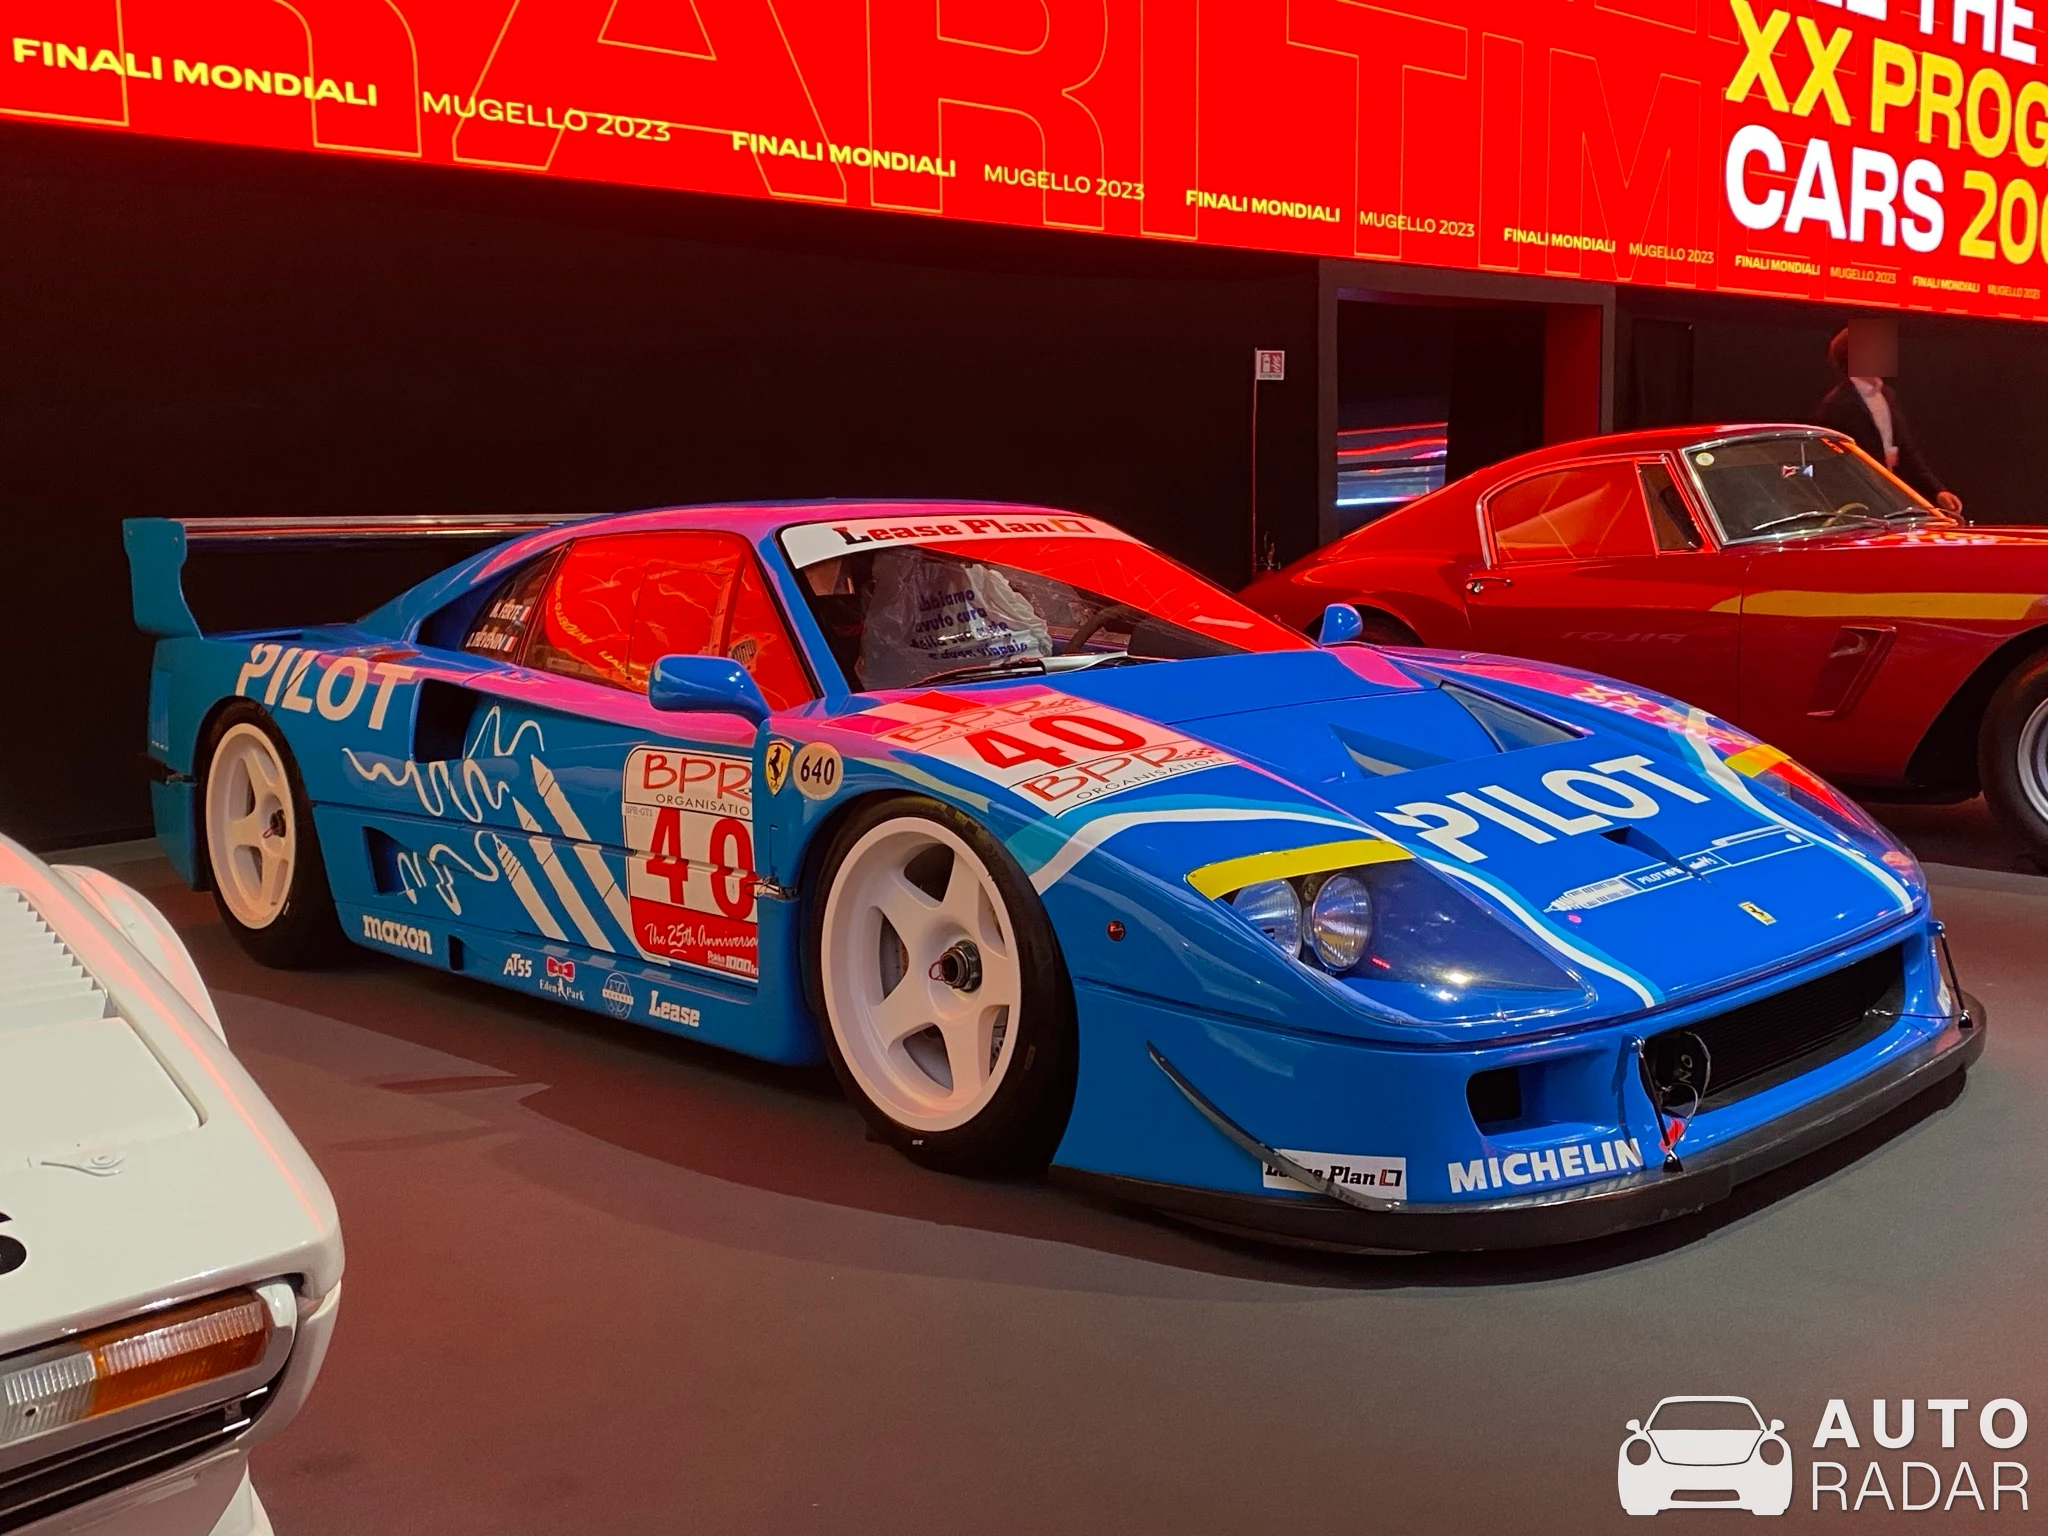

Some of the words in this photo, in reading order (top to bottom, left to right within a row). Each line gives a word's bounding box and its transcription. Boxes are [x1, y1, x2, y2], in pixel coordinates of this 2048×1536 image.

[12, 38, 162, 81] FINALI
[173, 59, 378, 107] MONDIALI
[1725, 0, 1853, 126] XX
[1870, 37, 2048, 168] PROG
[423, 91, 587, 131] MUGELLO
[596, 113, 671, 142] 2023
[732, 131, 824, 161] FINALI
[829, 144, 956, 178] MONDIALI
[984, 163, 1091, 194] MUGELLO
[1095, 178, 1145, 200] 2023
[1725, 124, 1945, 253] CARS
[1959, 169, 2048, 265] 20
[1185, 189, 1247, 213] FINALI
[1251, 198, 1341, 223] MONDIALI
[1359, 211, 1436, 233] MUGELLO
[1439, 220, 1475, 237] 2023
[1504, 227, 1548, 246] FINALI
[1551, 233, 1616, 253] MONDIALI
[1629, 243, 1686, 261] MUGELLO
[1687, 250, 1714, 264] 2023
[1735, 254, 1770, 271] FINALI
[1771, 259, 1820, 276] MONDIALI
[1830, 266, 1874, 282] MUGELLO
[1875, 270, 1896, 284] 2023
[832, 524, 962, 545] Lease
[958, 519, 1057, 534] Plan
[235, 643, 416, 730] PILOT
[964, 715, 1147, 769] 40
[643, 754, 752, 802] BPR
[800, 755, 835, 785] 640
[1022, 747, 1206, 801] BPR
[1076, 757, 1225, 799] ORGANISATION
[1375, 755, 1711, 863] PILOT
[646, 806, 756, 921] 40
[363, 914, 432, 955] maxon
[645, 923, 667, 945] The
[667, 923, 697, 953] 25th
[540, 979, 558, 993] Eden
[566, 986, 584, 1001] Park
[649, 990, 700, 1027] Lease
[1327, 1165, 1376, 1186] Plan
[1448, 1141, 1643, 1193] MICHELIN
